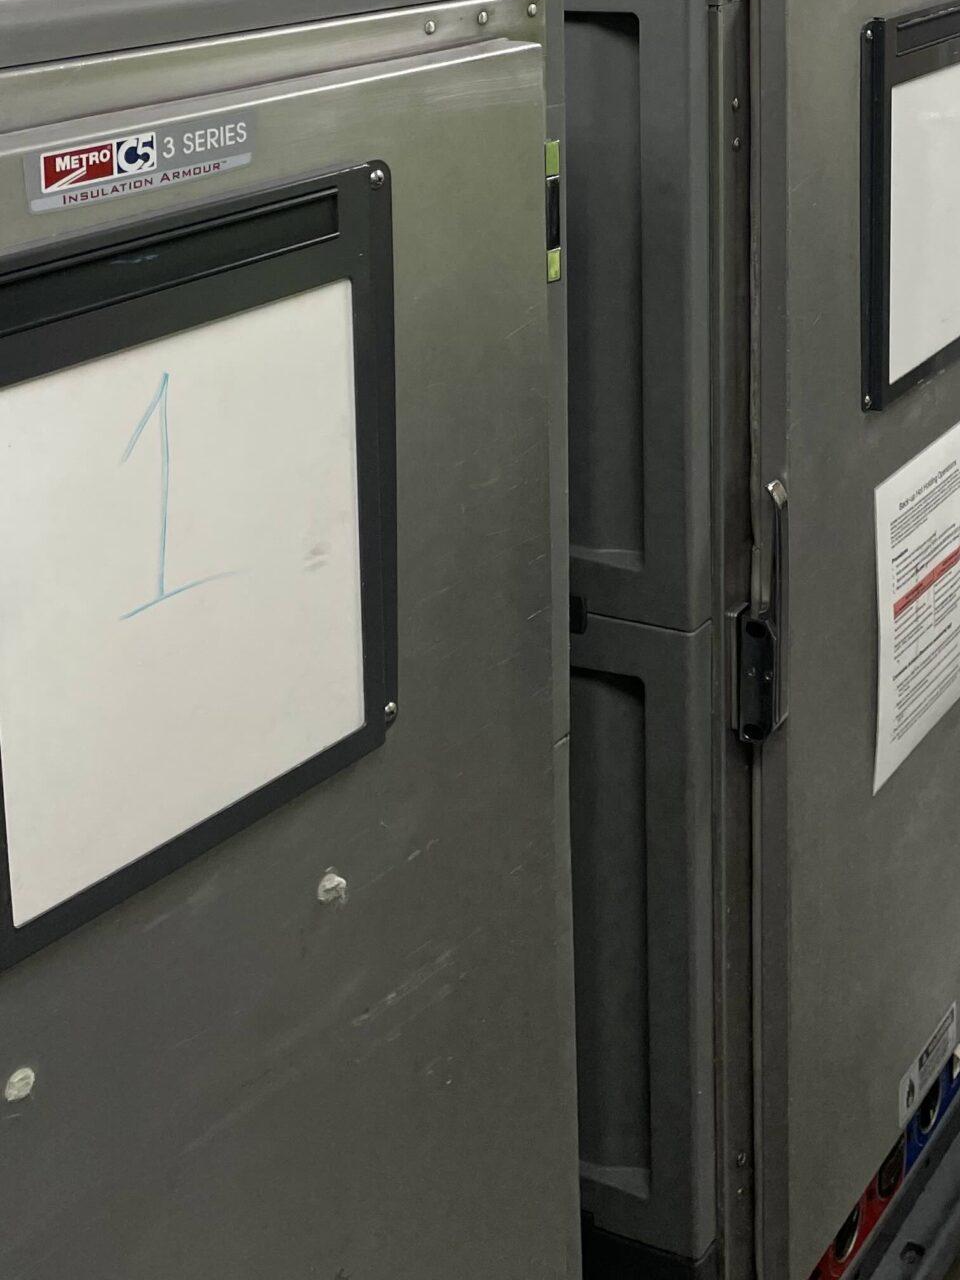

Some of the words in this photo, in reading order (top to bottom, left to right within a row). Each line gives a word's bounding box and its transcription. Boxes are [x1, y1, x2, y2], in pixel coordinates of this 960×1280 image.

[55, 148, 111, 173] METRO
[117, 135, 155, 174] C5
[162, 137, 175, 158] 3
[183, 122, 247, 154] SERIES
[62, 177, 154, 205] INSULATION
[119, 372, 250, 620] 1
